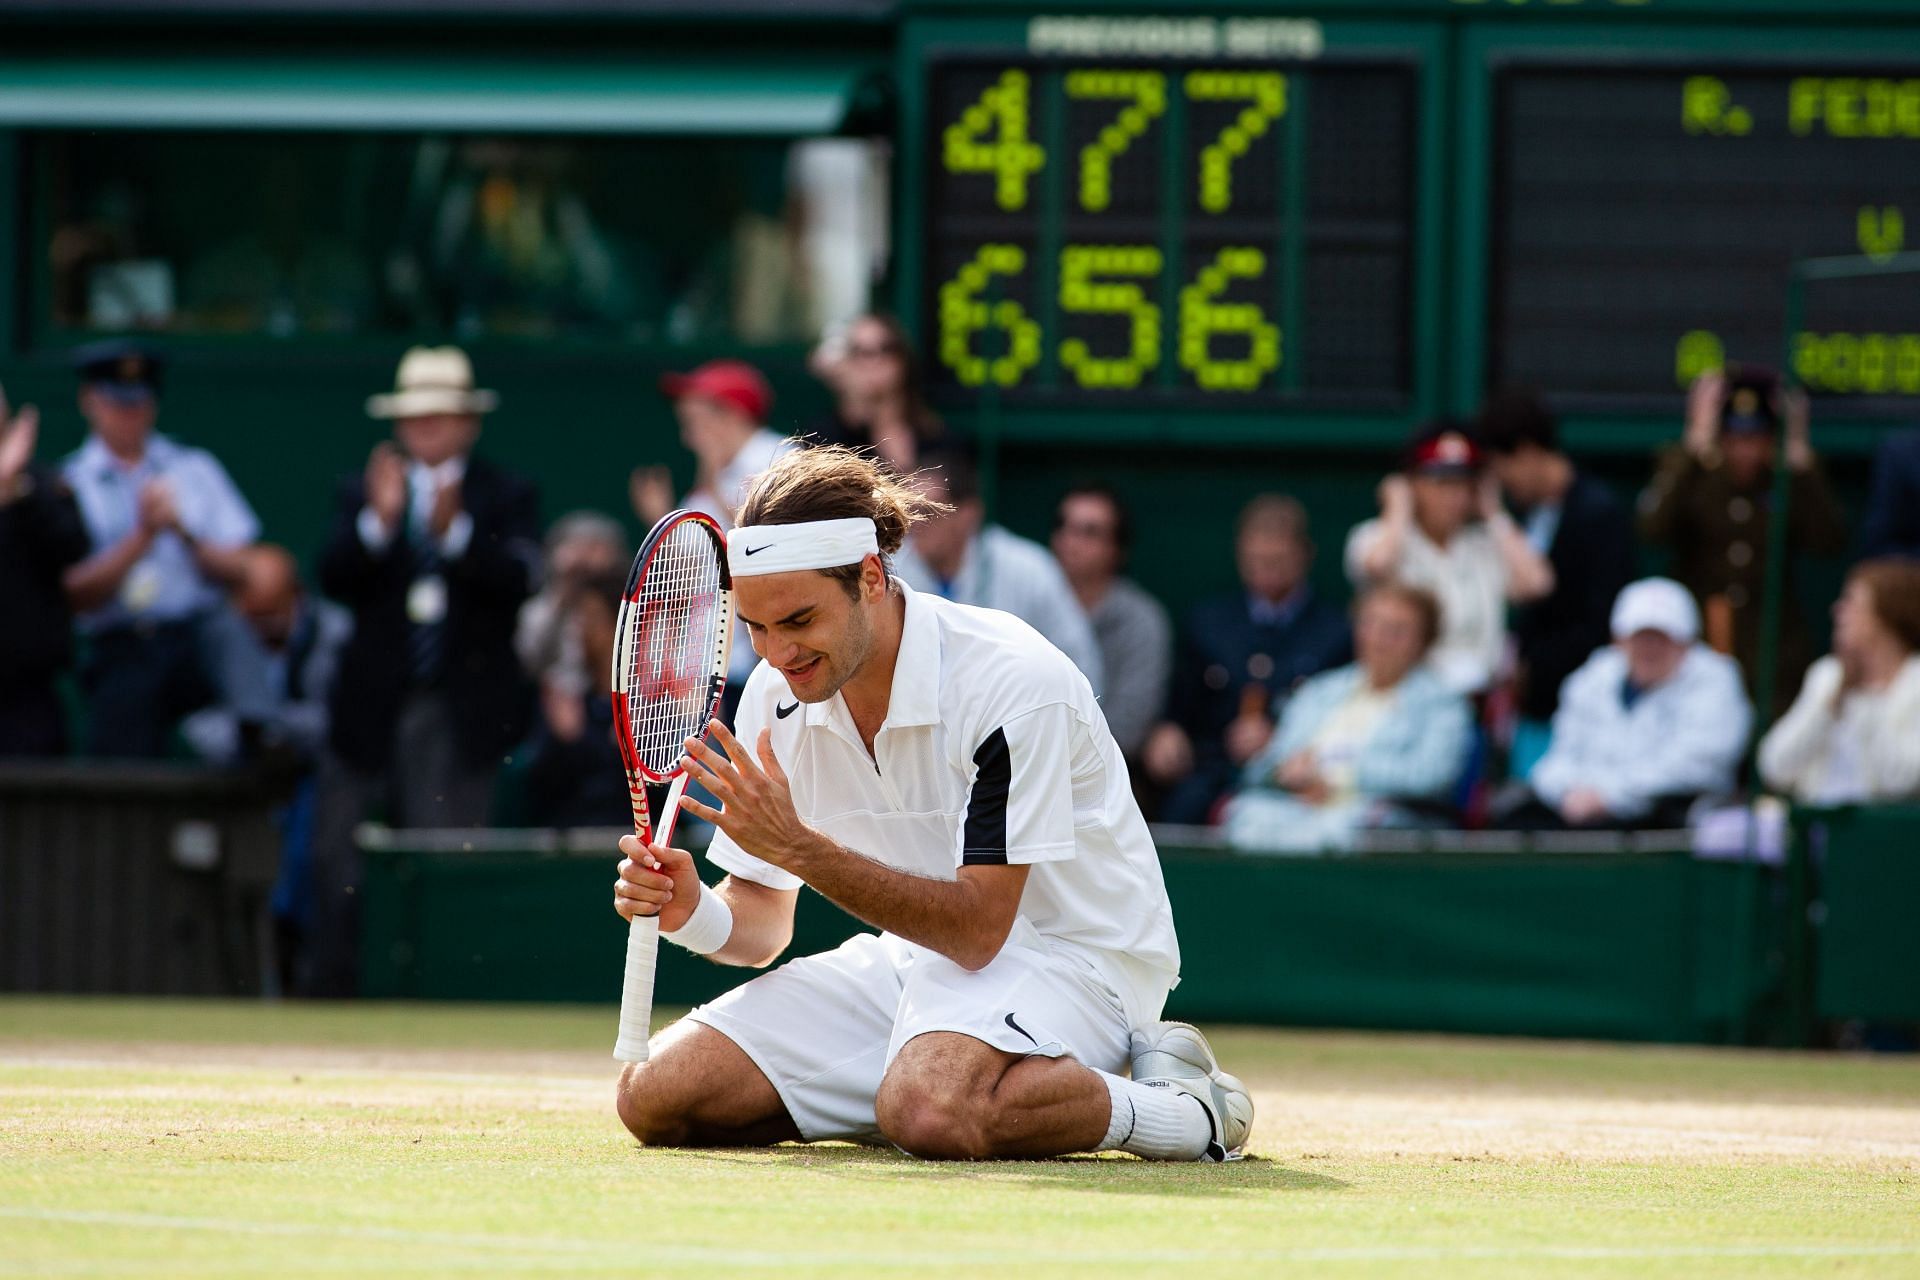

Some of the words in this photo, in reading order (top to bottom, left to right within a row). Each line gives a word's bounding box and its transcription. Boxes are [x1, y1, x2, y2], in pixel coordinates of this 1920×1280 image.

[1028, 17, 1216, 57] PREVIOUS
[1222, 18, 1323, 59] SETS
[944, 70, 1046, 211] 4
[1065, 72, 1166, 211] 7
[1185, 73, 1286, 212] 7
[939, 244, 1041, 386] 6
[1059, 246, 1161, 388] 5
[1179, 247, 1279, 389] 6
